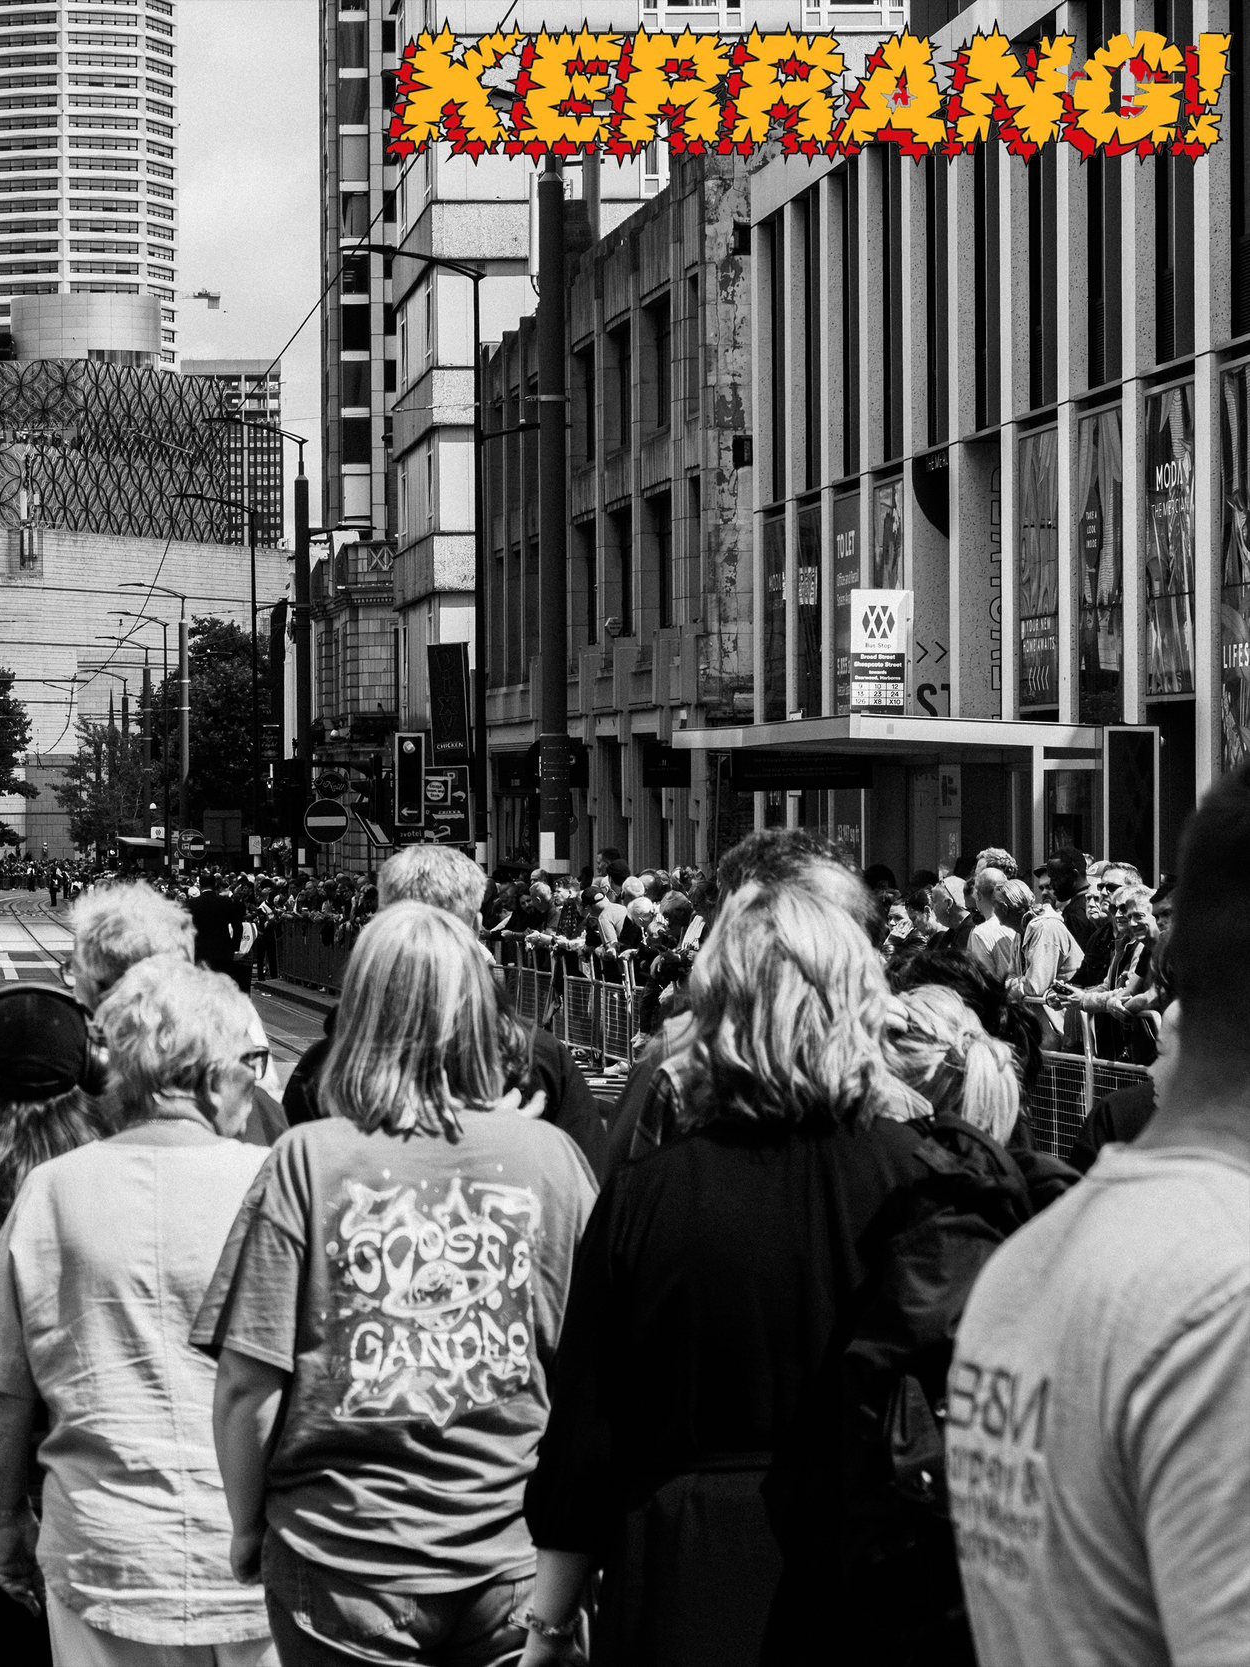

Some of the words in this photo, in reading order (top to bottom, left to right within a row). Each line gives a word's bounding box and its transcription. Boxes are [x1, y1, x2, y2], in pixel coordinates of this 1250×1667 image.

[1156, 460, 1183, 491] MODA
[1087, 525, 1096, 534] LOOK
[845, 530, 855, 556] LET
